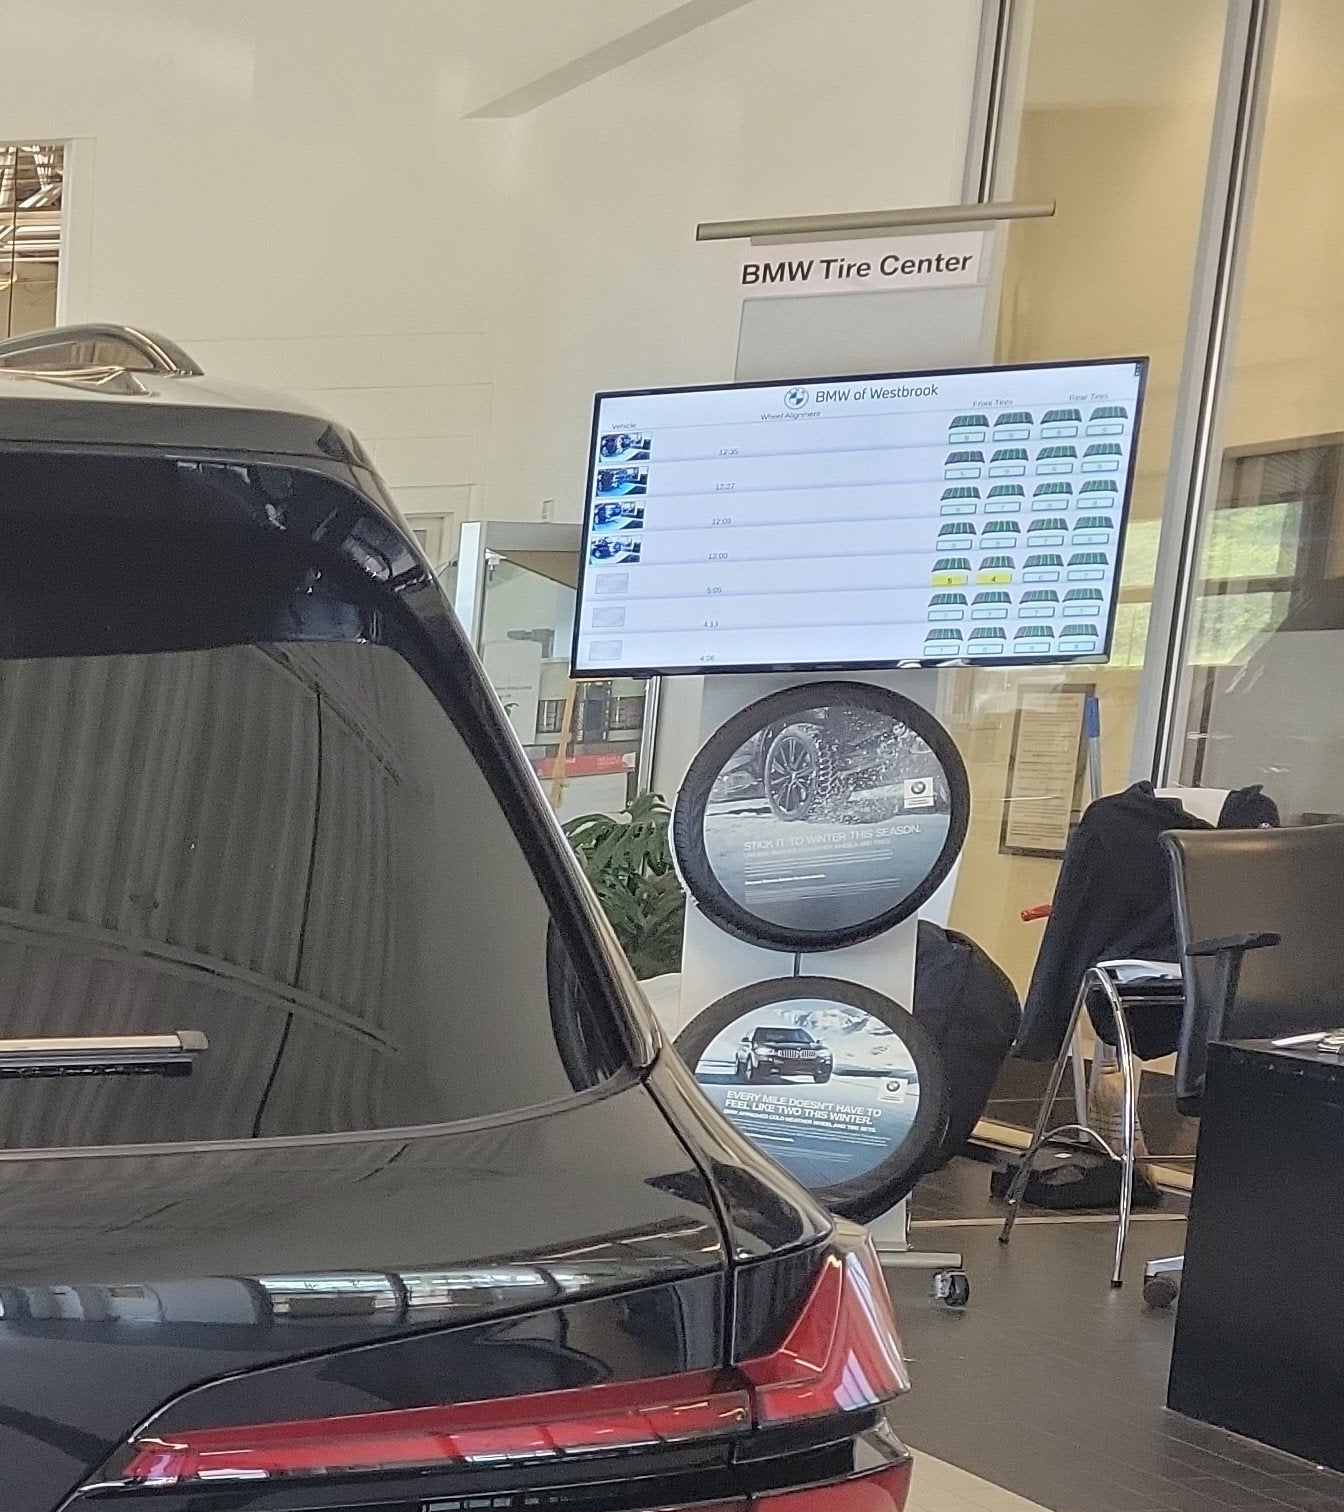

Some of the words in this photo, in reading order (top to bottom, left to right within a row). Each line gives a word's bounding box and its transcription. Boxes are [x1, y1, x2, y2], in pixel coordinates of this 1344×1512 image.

[741, 260, 814, 285] BMW
[820, 257, 872, 280] Tire
[879, 253, 973, 276] Center
[815, 389, 851, 403] BMW
[853, 387, 868, 400] of
[870, 384, 939, 399] Westbrook
[744, 839, 774, 851] STICK
[789, 836, 803, 846] TO
[807, 833, 846, 844] WINTER
[850, 829, 874, 840] THIS
[725, 1099, 750, 1110] FEEL
[752, 1103, 776, 1113] LIKE
[777, 1105, 802, 1116] TWO
[804, 1108, 828, 1119] THIS
[830, 1112, 873, 1125] WINTER.
[726, 1090, 761, 1102] EVERY
[762, 1096, 787, 1105] MILE
[788, 1098, 834, 1111] DOESN'T
[835, 1104, 866, 1115] HAVE
[867, 1107, 882, 1118] TO
